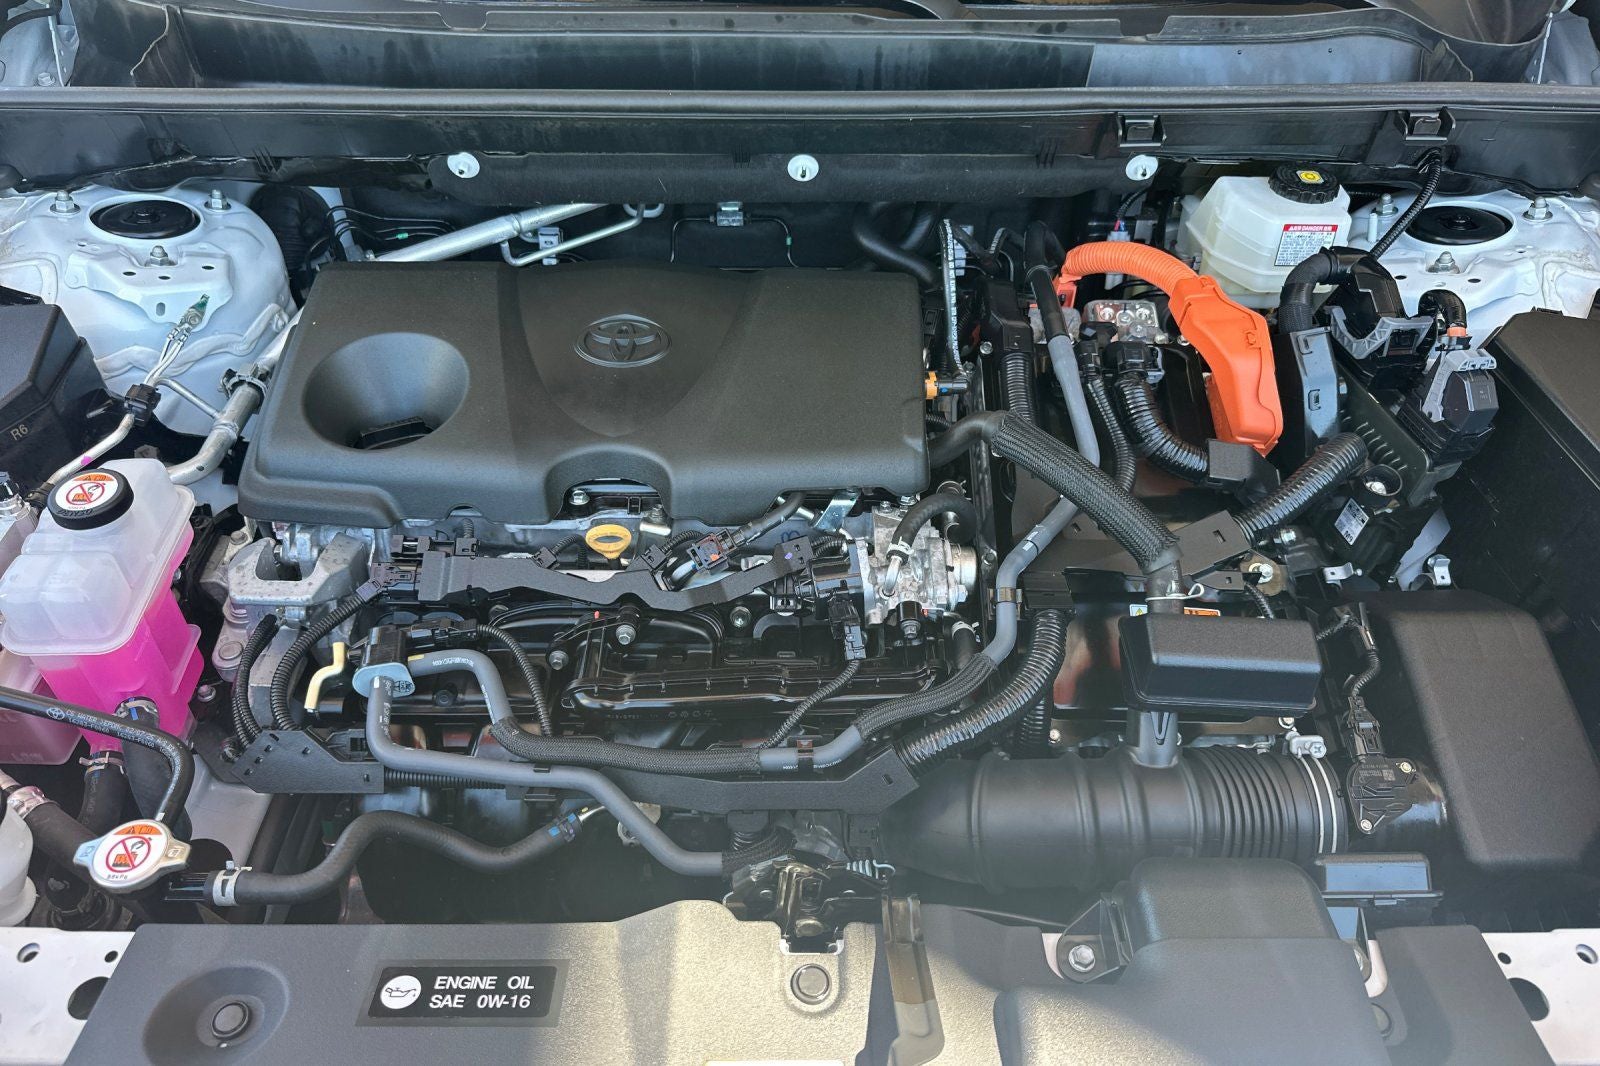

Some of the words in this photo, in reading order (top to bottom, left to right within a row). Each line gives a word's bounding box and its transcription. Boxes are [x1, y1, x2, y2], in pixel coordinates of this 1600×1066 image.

[10, 424, 28, 440] R6
[434, 975, 498, 990] ENGINE
[507, 975, 535, 990] OIL
[429, 994, 467, 1009] SAE
[476, 994, 532, 1009] 0W-16
